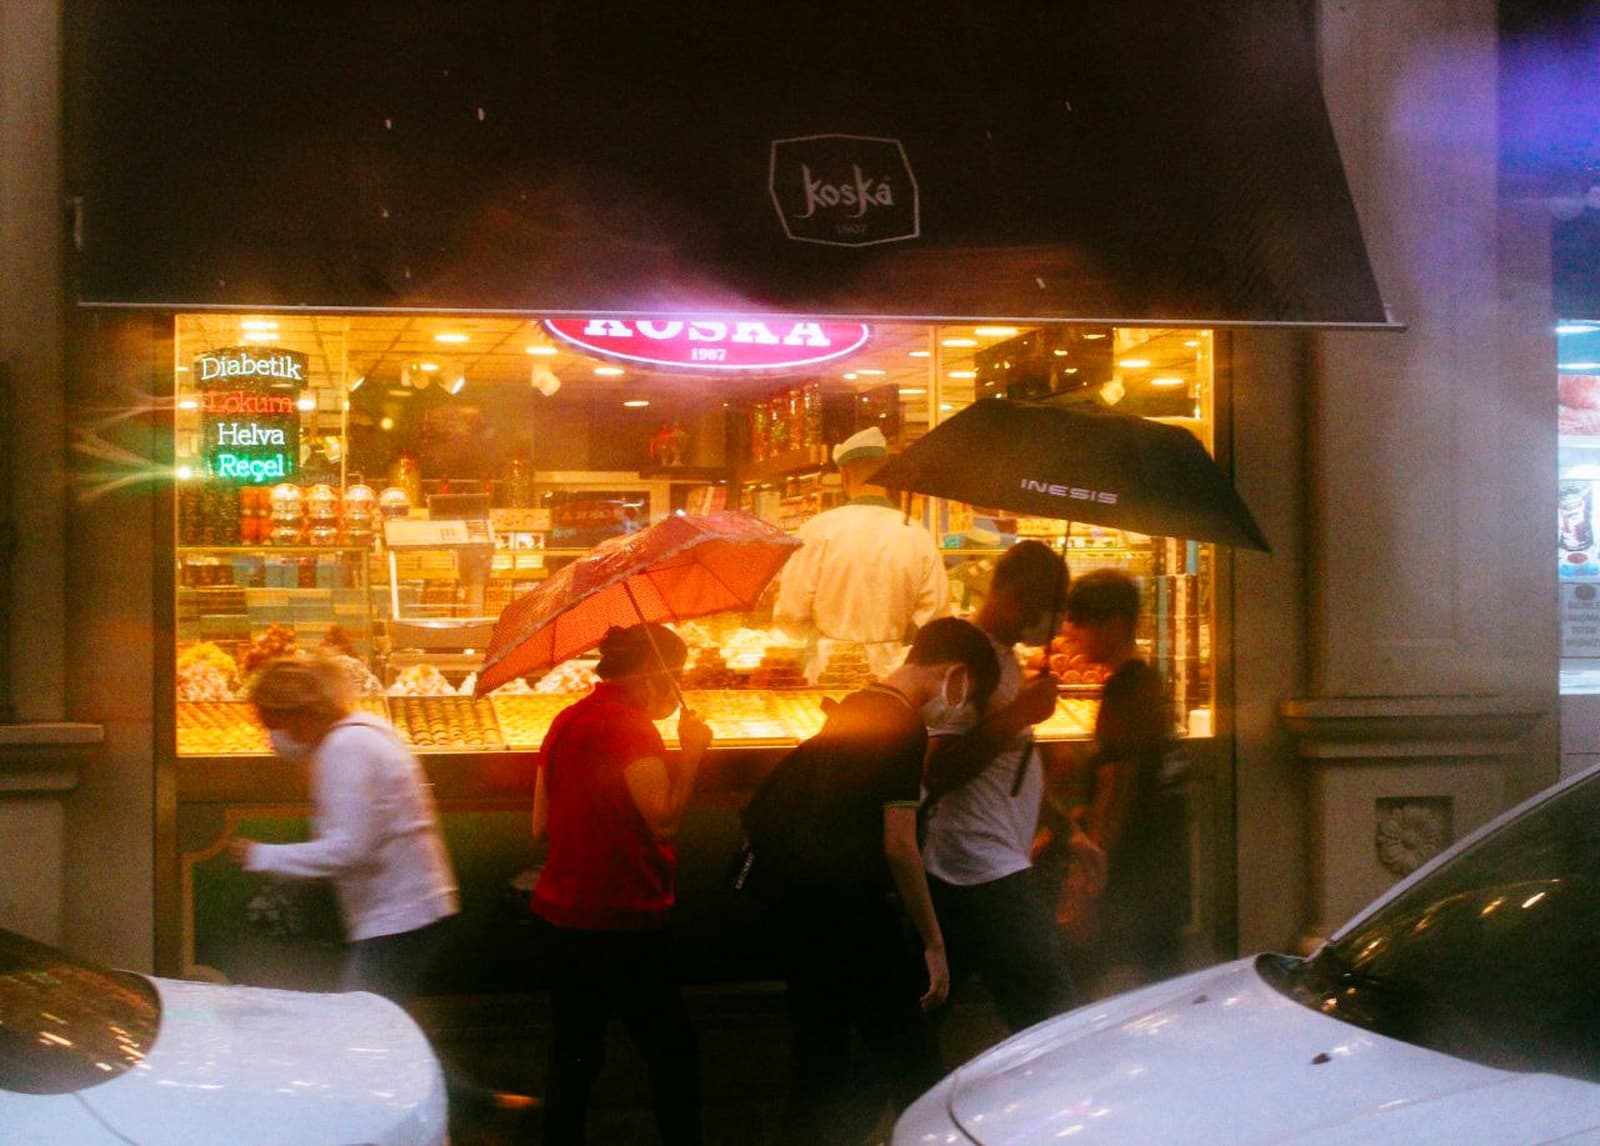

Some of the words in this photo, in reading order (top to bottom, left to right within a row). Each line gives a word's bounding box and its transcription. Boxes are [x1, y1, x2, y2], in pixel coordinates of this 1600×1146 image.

[792, 163, 896, 219] koska
[201, 353, 302, 380] Diabetik
[691, 347, 728, 361] 1907
[207, 390, 294, 413] Lokum
[217, 422, 286, 446] Helva
[217, 453, 286, 483] Reçel
[1020, 478, 1119, 505] INESIS
